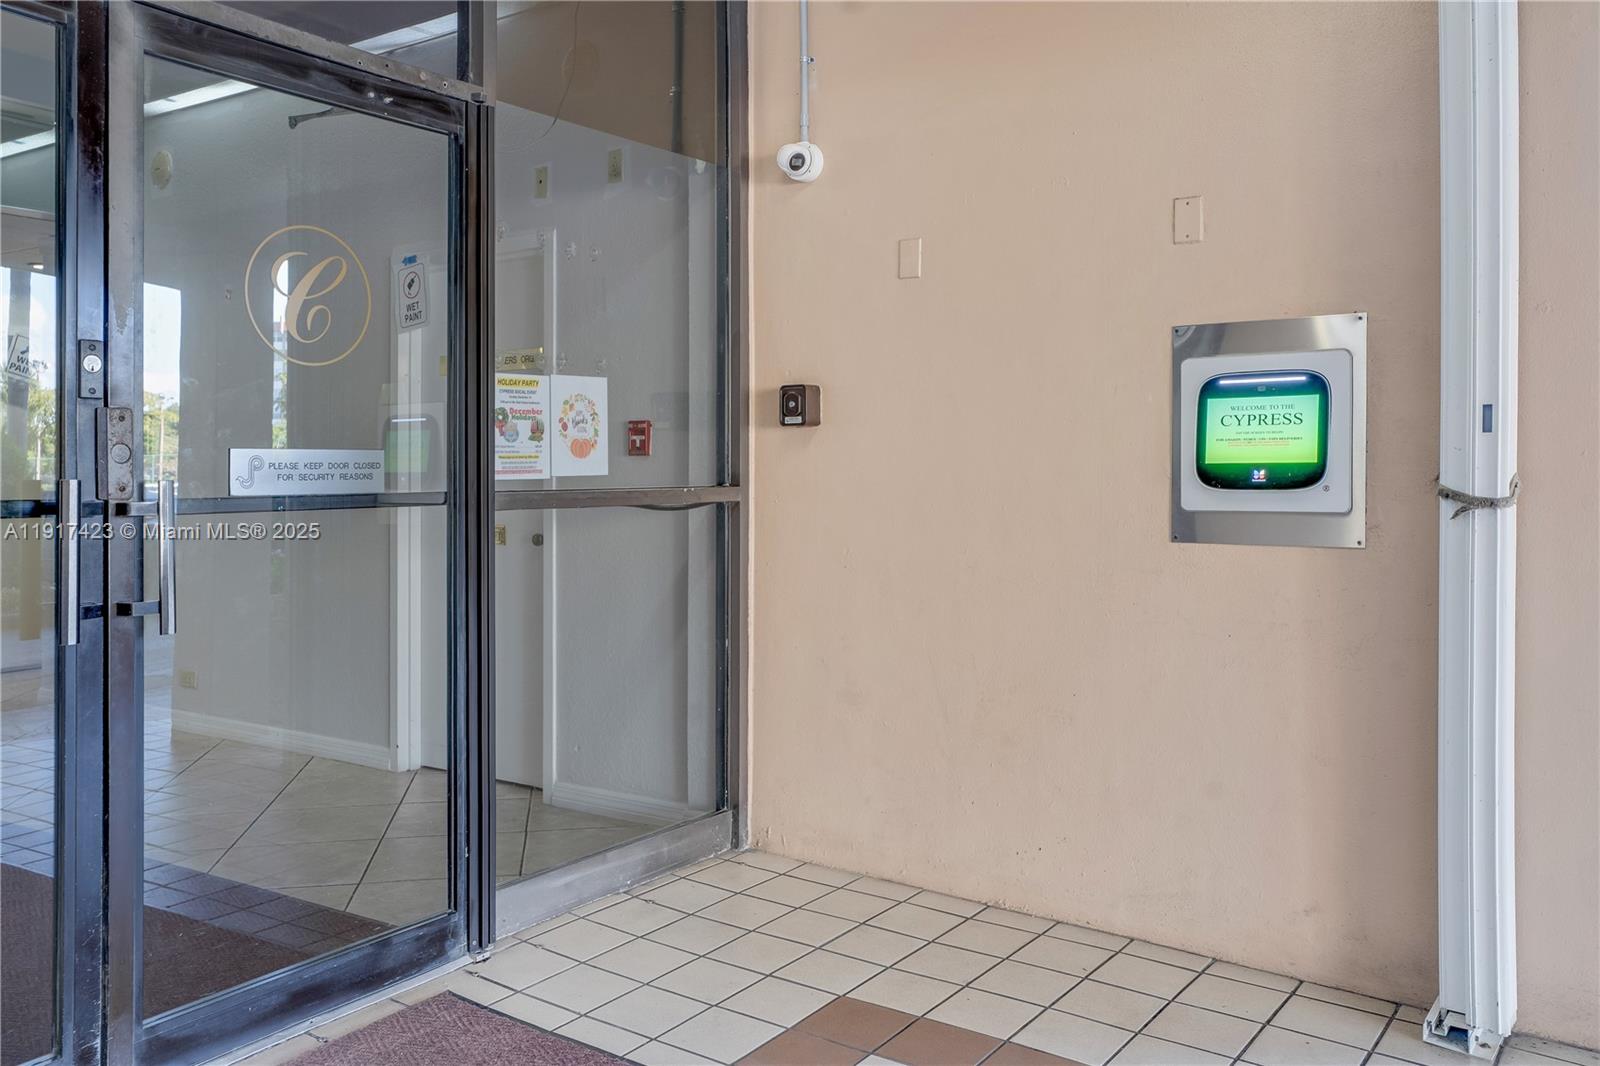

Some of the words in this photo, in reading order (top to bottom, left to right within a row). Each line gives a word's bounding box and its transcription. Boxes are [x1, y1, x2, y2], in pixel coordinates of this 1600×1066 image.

[405, 301, 420, 312] WET
[404, 310, 422, 323] PAINT
[496, 378, 521, 386] HOLIDAY
[521, 379, 539, 387] PARTY
[509, 407, 543, 415] December
[1220, 412, 1303, 427] CYPRESS
[268, 462, 299, 470] PLEASE
[304, 462, 323, 470] KEEP
[328, 462, 349, 470] DOOR
[353, 462, 381, 470] CLOSED
[277, 473, 294, 481] FOR
[299, 473, 334, 481] SECURITY
[339, 473, 373, 481] REASONS
